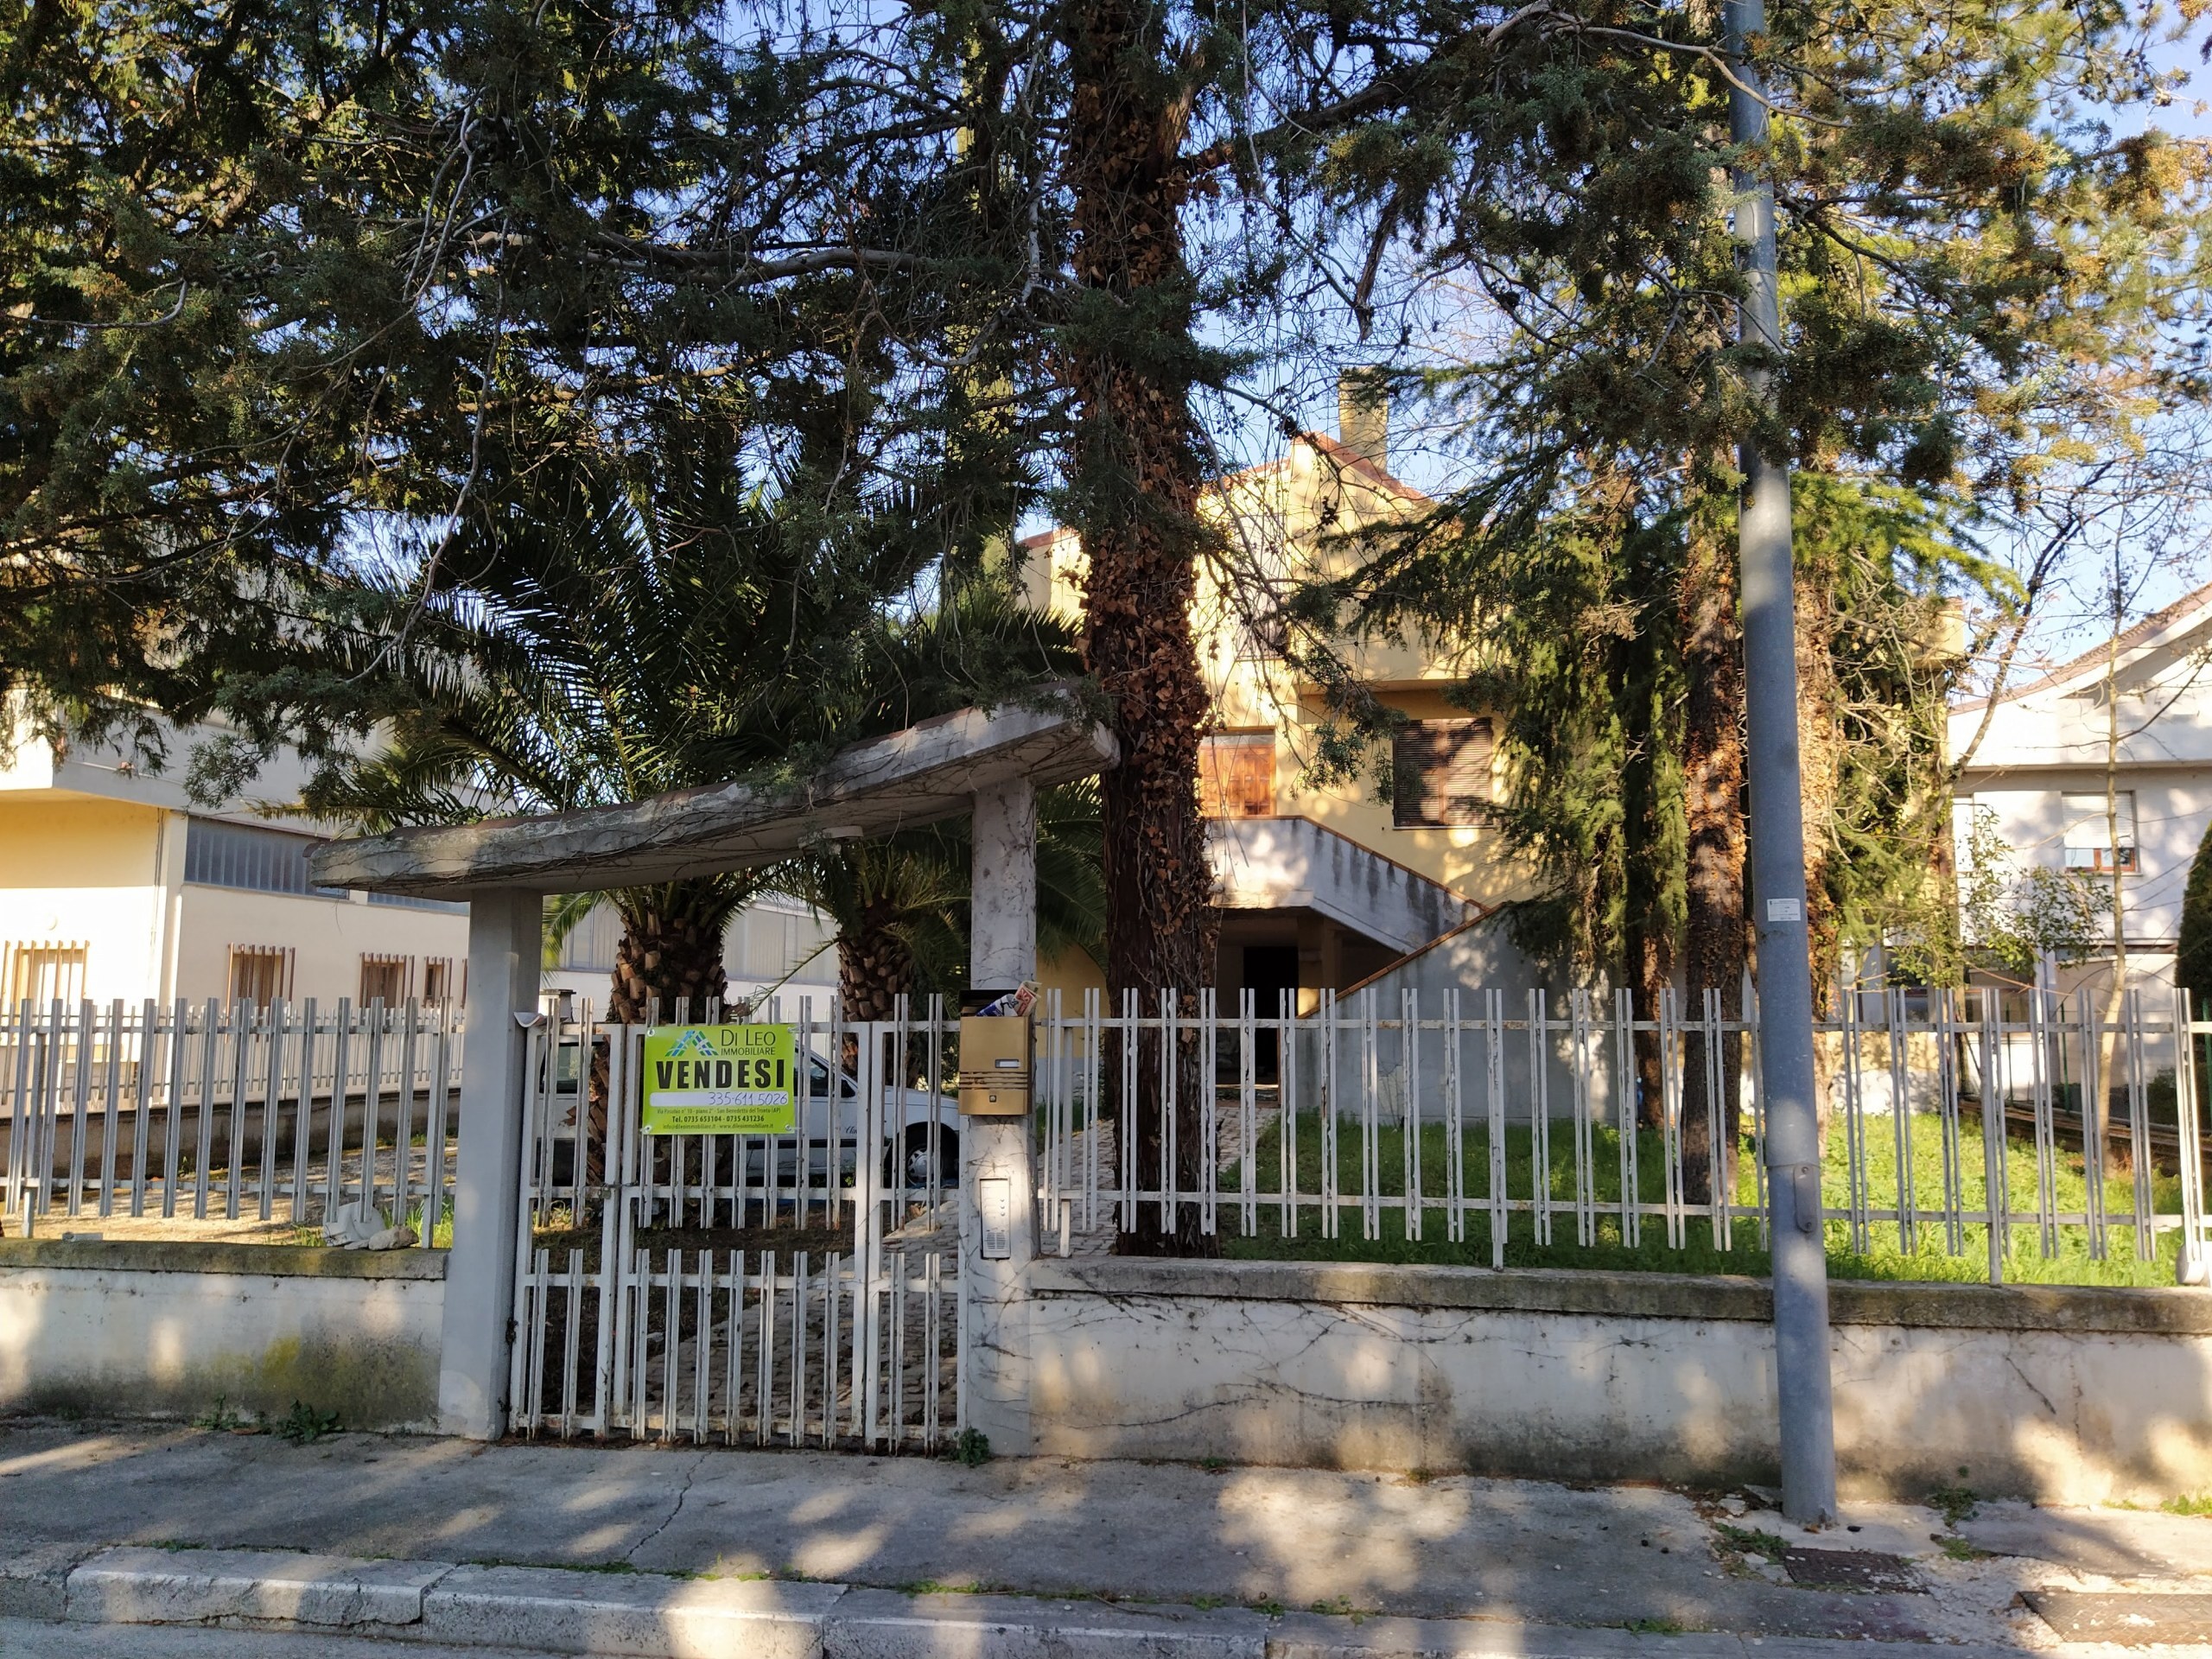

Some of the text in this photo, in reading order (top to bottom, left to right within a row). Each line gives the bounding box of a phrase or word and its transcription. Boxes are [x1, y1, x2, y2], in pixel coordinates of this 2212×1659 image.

[746, 1029, 776, 1046] LEO
[721, 1047, 776, 1056] IMMOBILIARE
[656, 1058, 785, 1090] VENDESI
[758, 1093, 788, 1106] 5026
